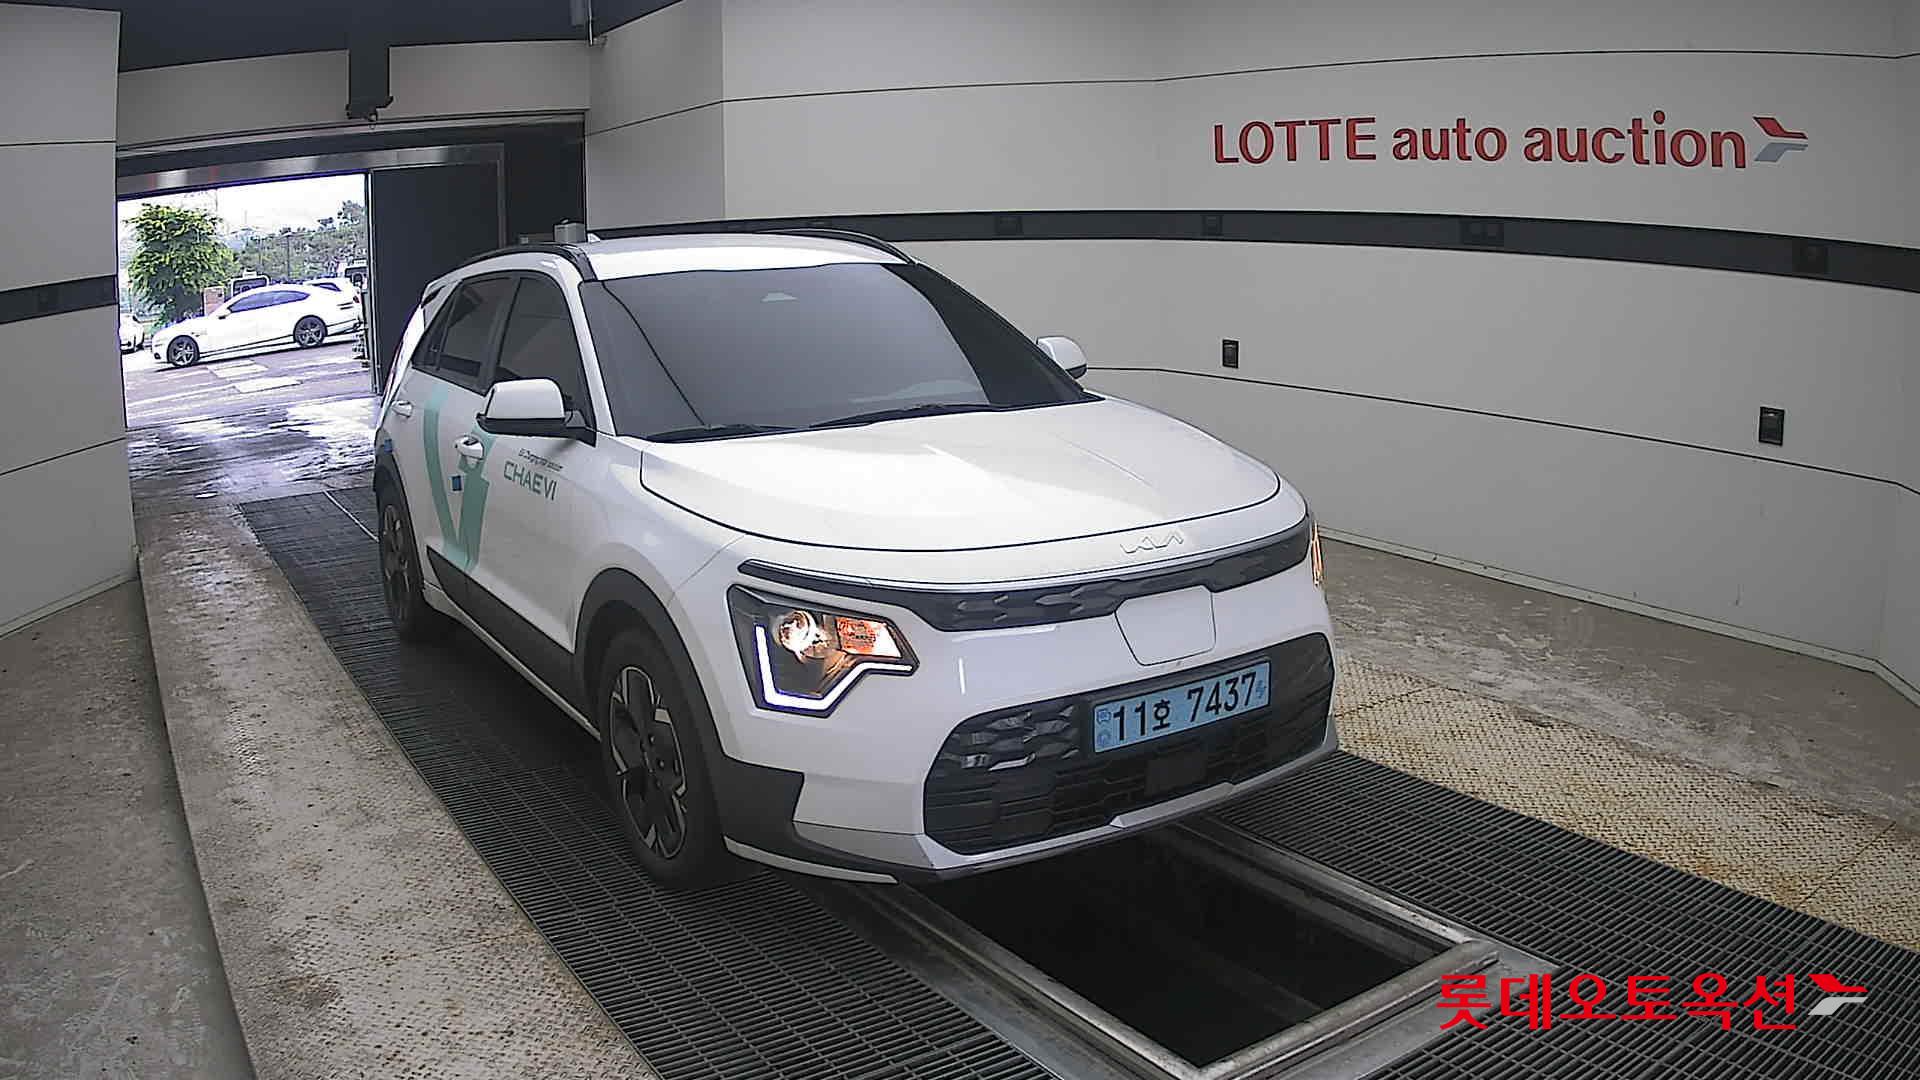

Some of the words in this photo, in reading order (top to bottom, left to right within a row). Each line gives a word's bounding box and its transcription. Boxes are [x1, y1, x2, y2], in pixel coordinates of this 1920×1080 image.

[1213, 116, 1377, 164] LOTTE
[1391, 117, 1509, 162] auto
[1523, 110, 1747, 169] auction
[503, 460, 557, 501] CHAEVI
[1113, 699, 1171, 741] 11호
[1187, 671, 1257, 723] 7437
